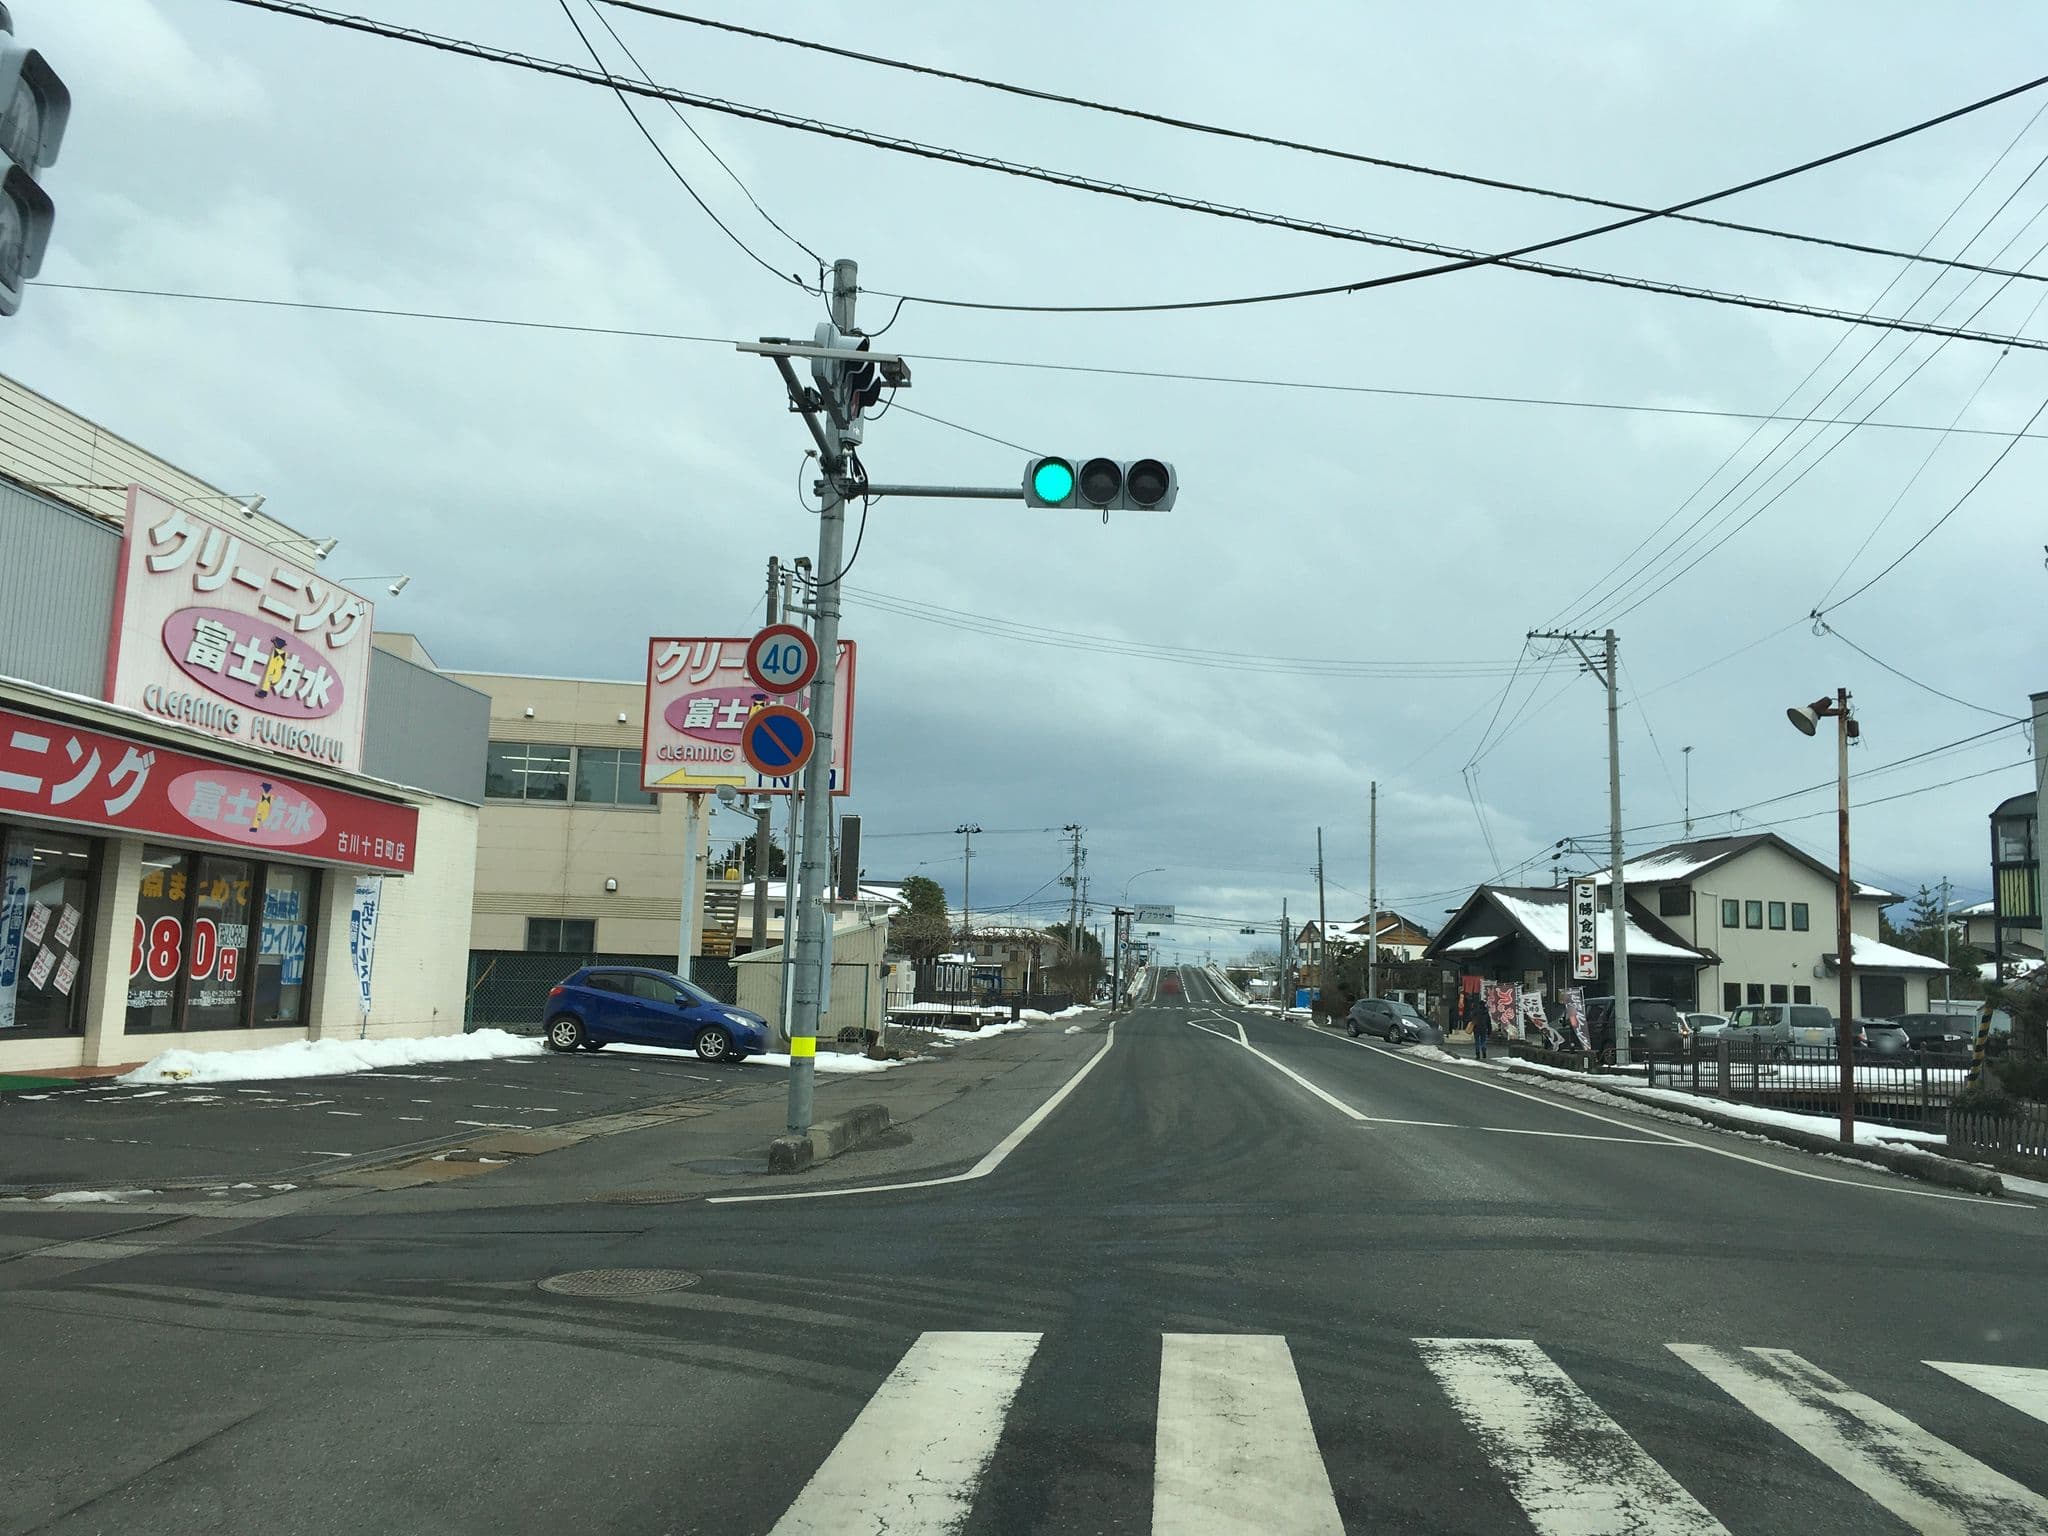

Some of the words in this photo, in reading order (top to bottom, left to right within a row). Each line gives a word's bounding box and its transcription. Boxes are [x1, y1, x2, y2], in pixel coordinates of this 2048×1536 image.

[146, 508, 367, 649] クリーニング
[184, 616, 333, 709] 富士防水
[762, 644, 802, 675] 40
[143, 683, 241, 735] CLEANING
[250, 716, 344, 764] FUJIBOUSUI
[657, 745, 735, 763] CLEANING
[188, 780, 315, 836] 富士防水
[338, 831, 406, 862] 古川十日町店
[1579, 885, 1593, 949] 三勝食堂
[1580, 954, 1593, 967] P
